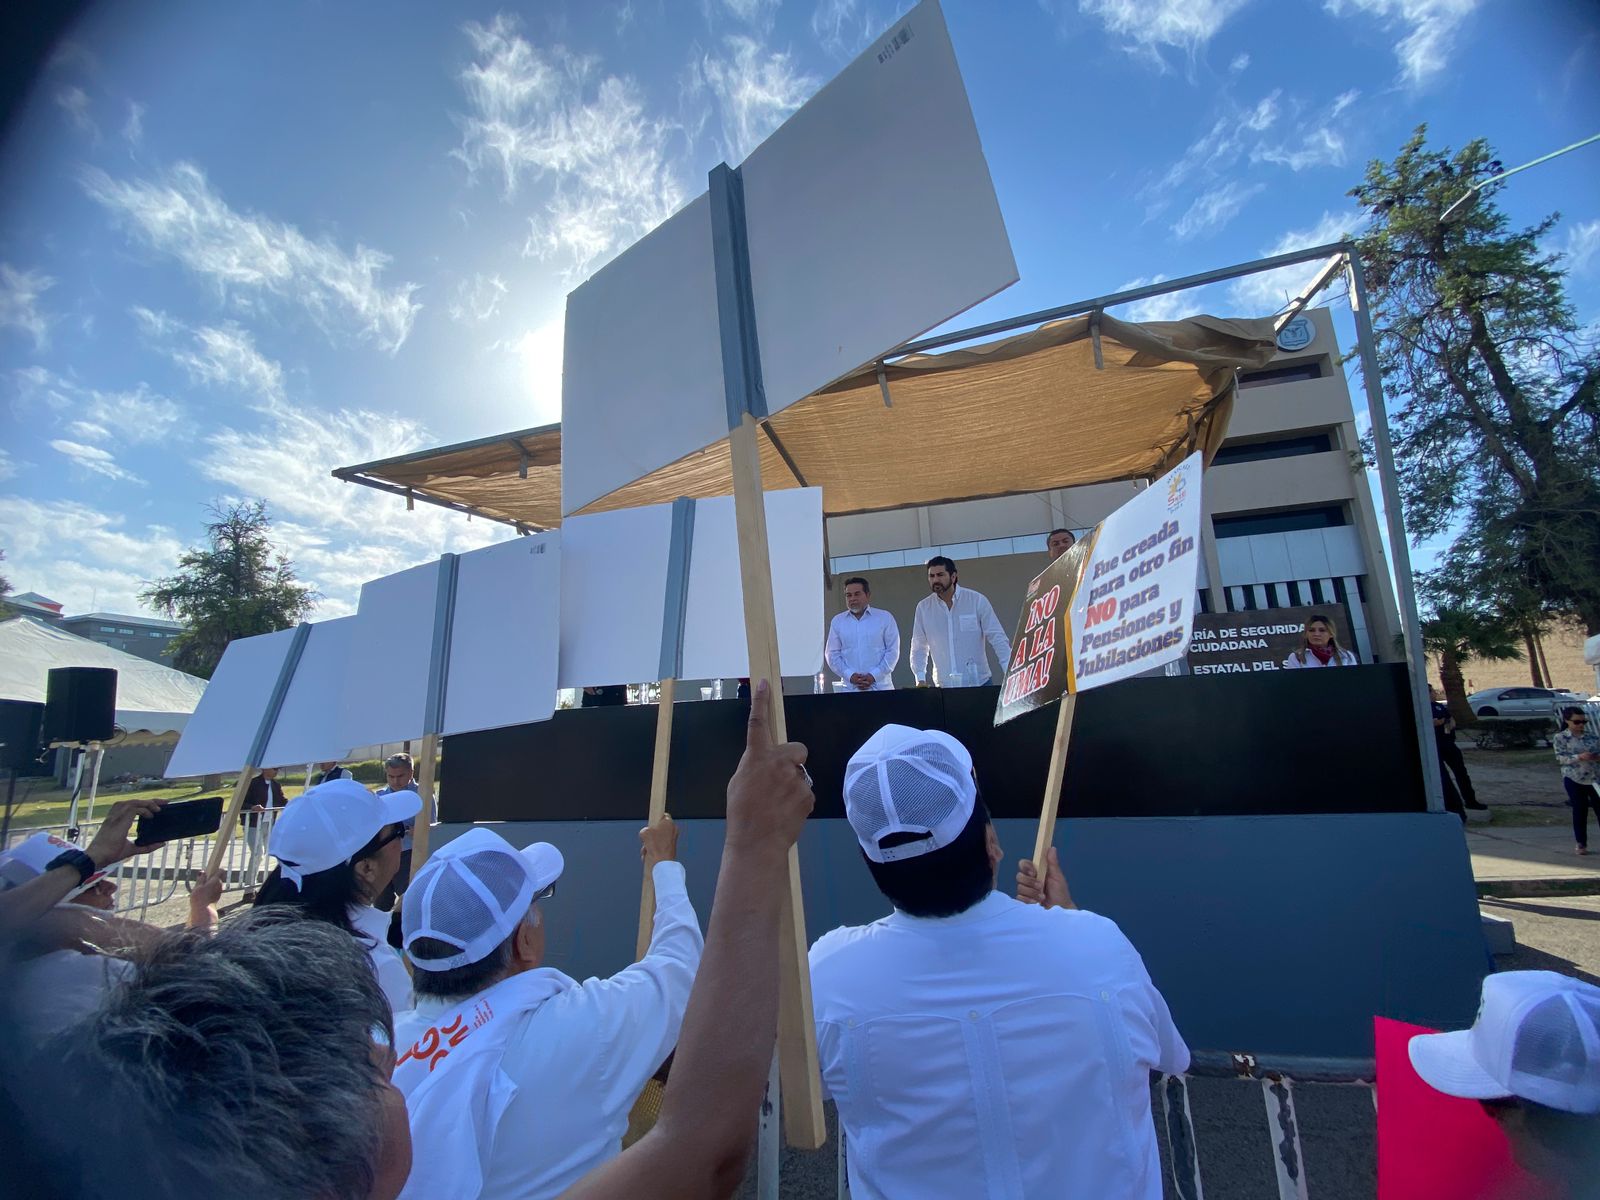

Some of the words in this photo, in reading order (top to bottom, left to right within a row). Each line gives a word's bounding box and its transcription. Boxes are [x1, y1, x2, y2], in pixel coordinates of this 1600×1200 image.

[1088, 574, 1125, 606] para
[1129, 552, 1165, 582] otro
[1168, 536, 1194, 563] fin
[1093, 556, 1119, 580] Fue
[1122, 520, 1179, 563] creada
[1080, 607, 1166, 654] Pensiones
[1169, 598, 1183, 625] y
[1084, 597, 1117, 629] NO
[1118, 584, 1160, 620] para
[1220, 628, 1238, 638] DE
[1011, 637, 1027, 671] A
[1029, 617, 1055, 661] LA
[1075, 625, 1184, 679] Jubilaciones
[1190, 638, 1269, 652] CIUDADANA
[1193, 663, 1250, 675] ESTATAL
[1252, 661, 1280, 673] DEL
[1002, 648, 1055, 707] UMA!
